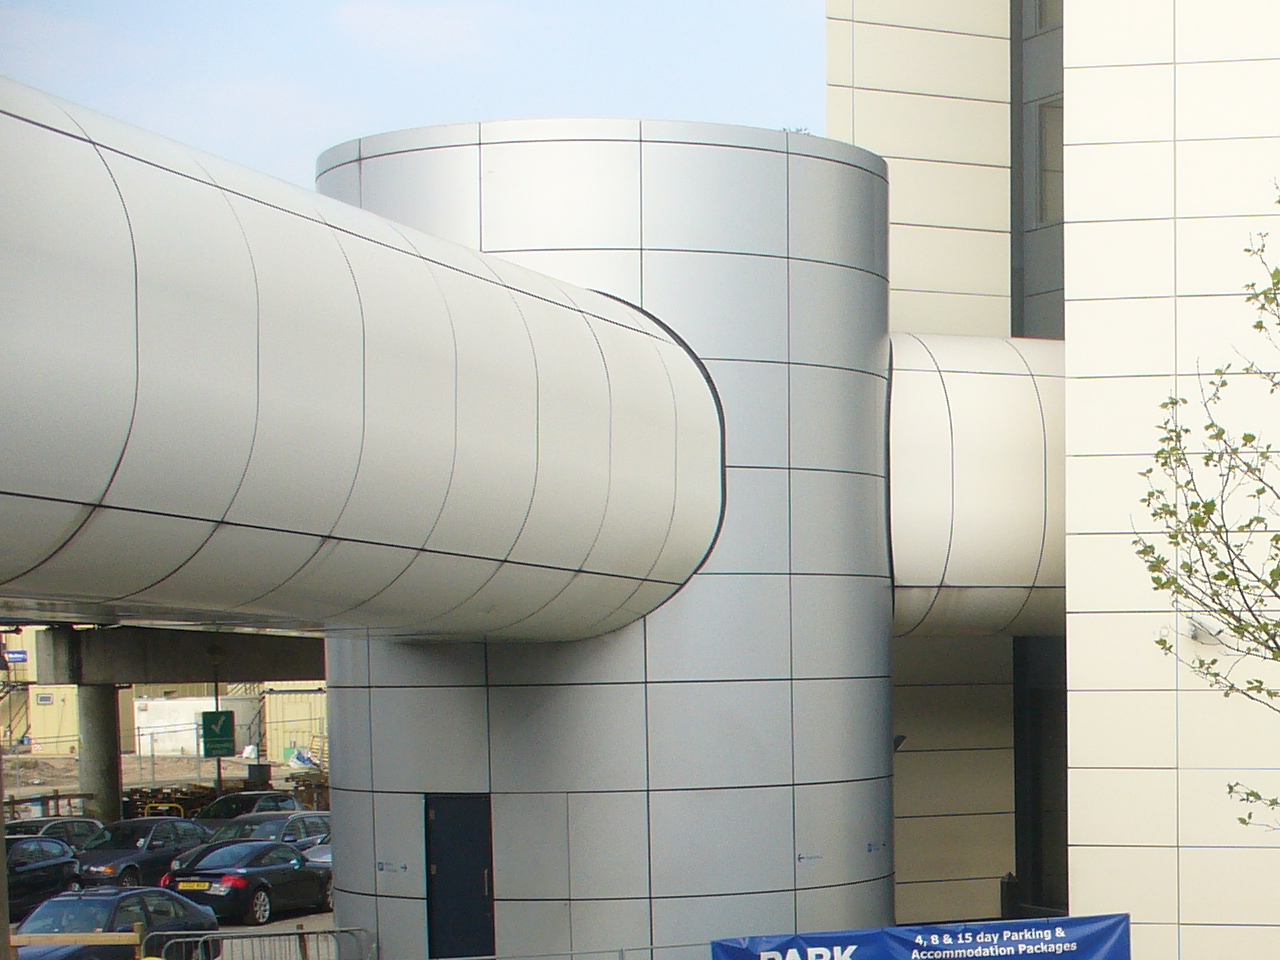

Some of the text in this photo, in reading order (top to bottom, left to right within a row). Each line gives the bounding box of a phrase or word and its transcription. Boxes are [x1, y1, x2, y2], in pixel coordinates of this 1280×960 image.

[914, 927, 1066, 947] 4, 8 & 15 day Parking &
[911, 942, 1077, 960] Accommodation Packages
